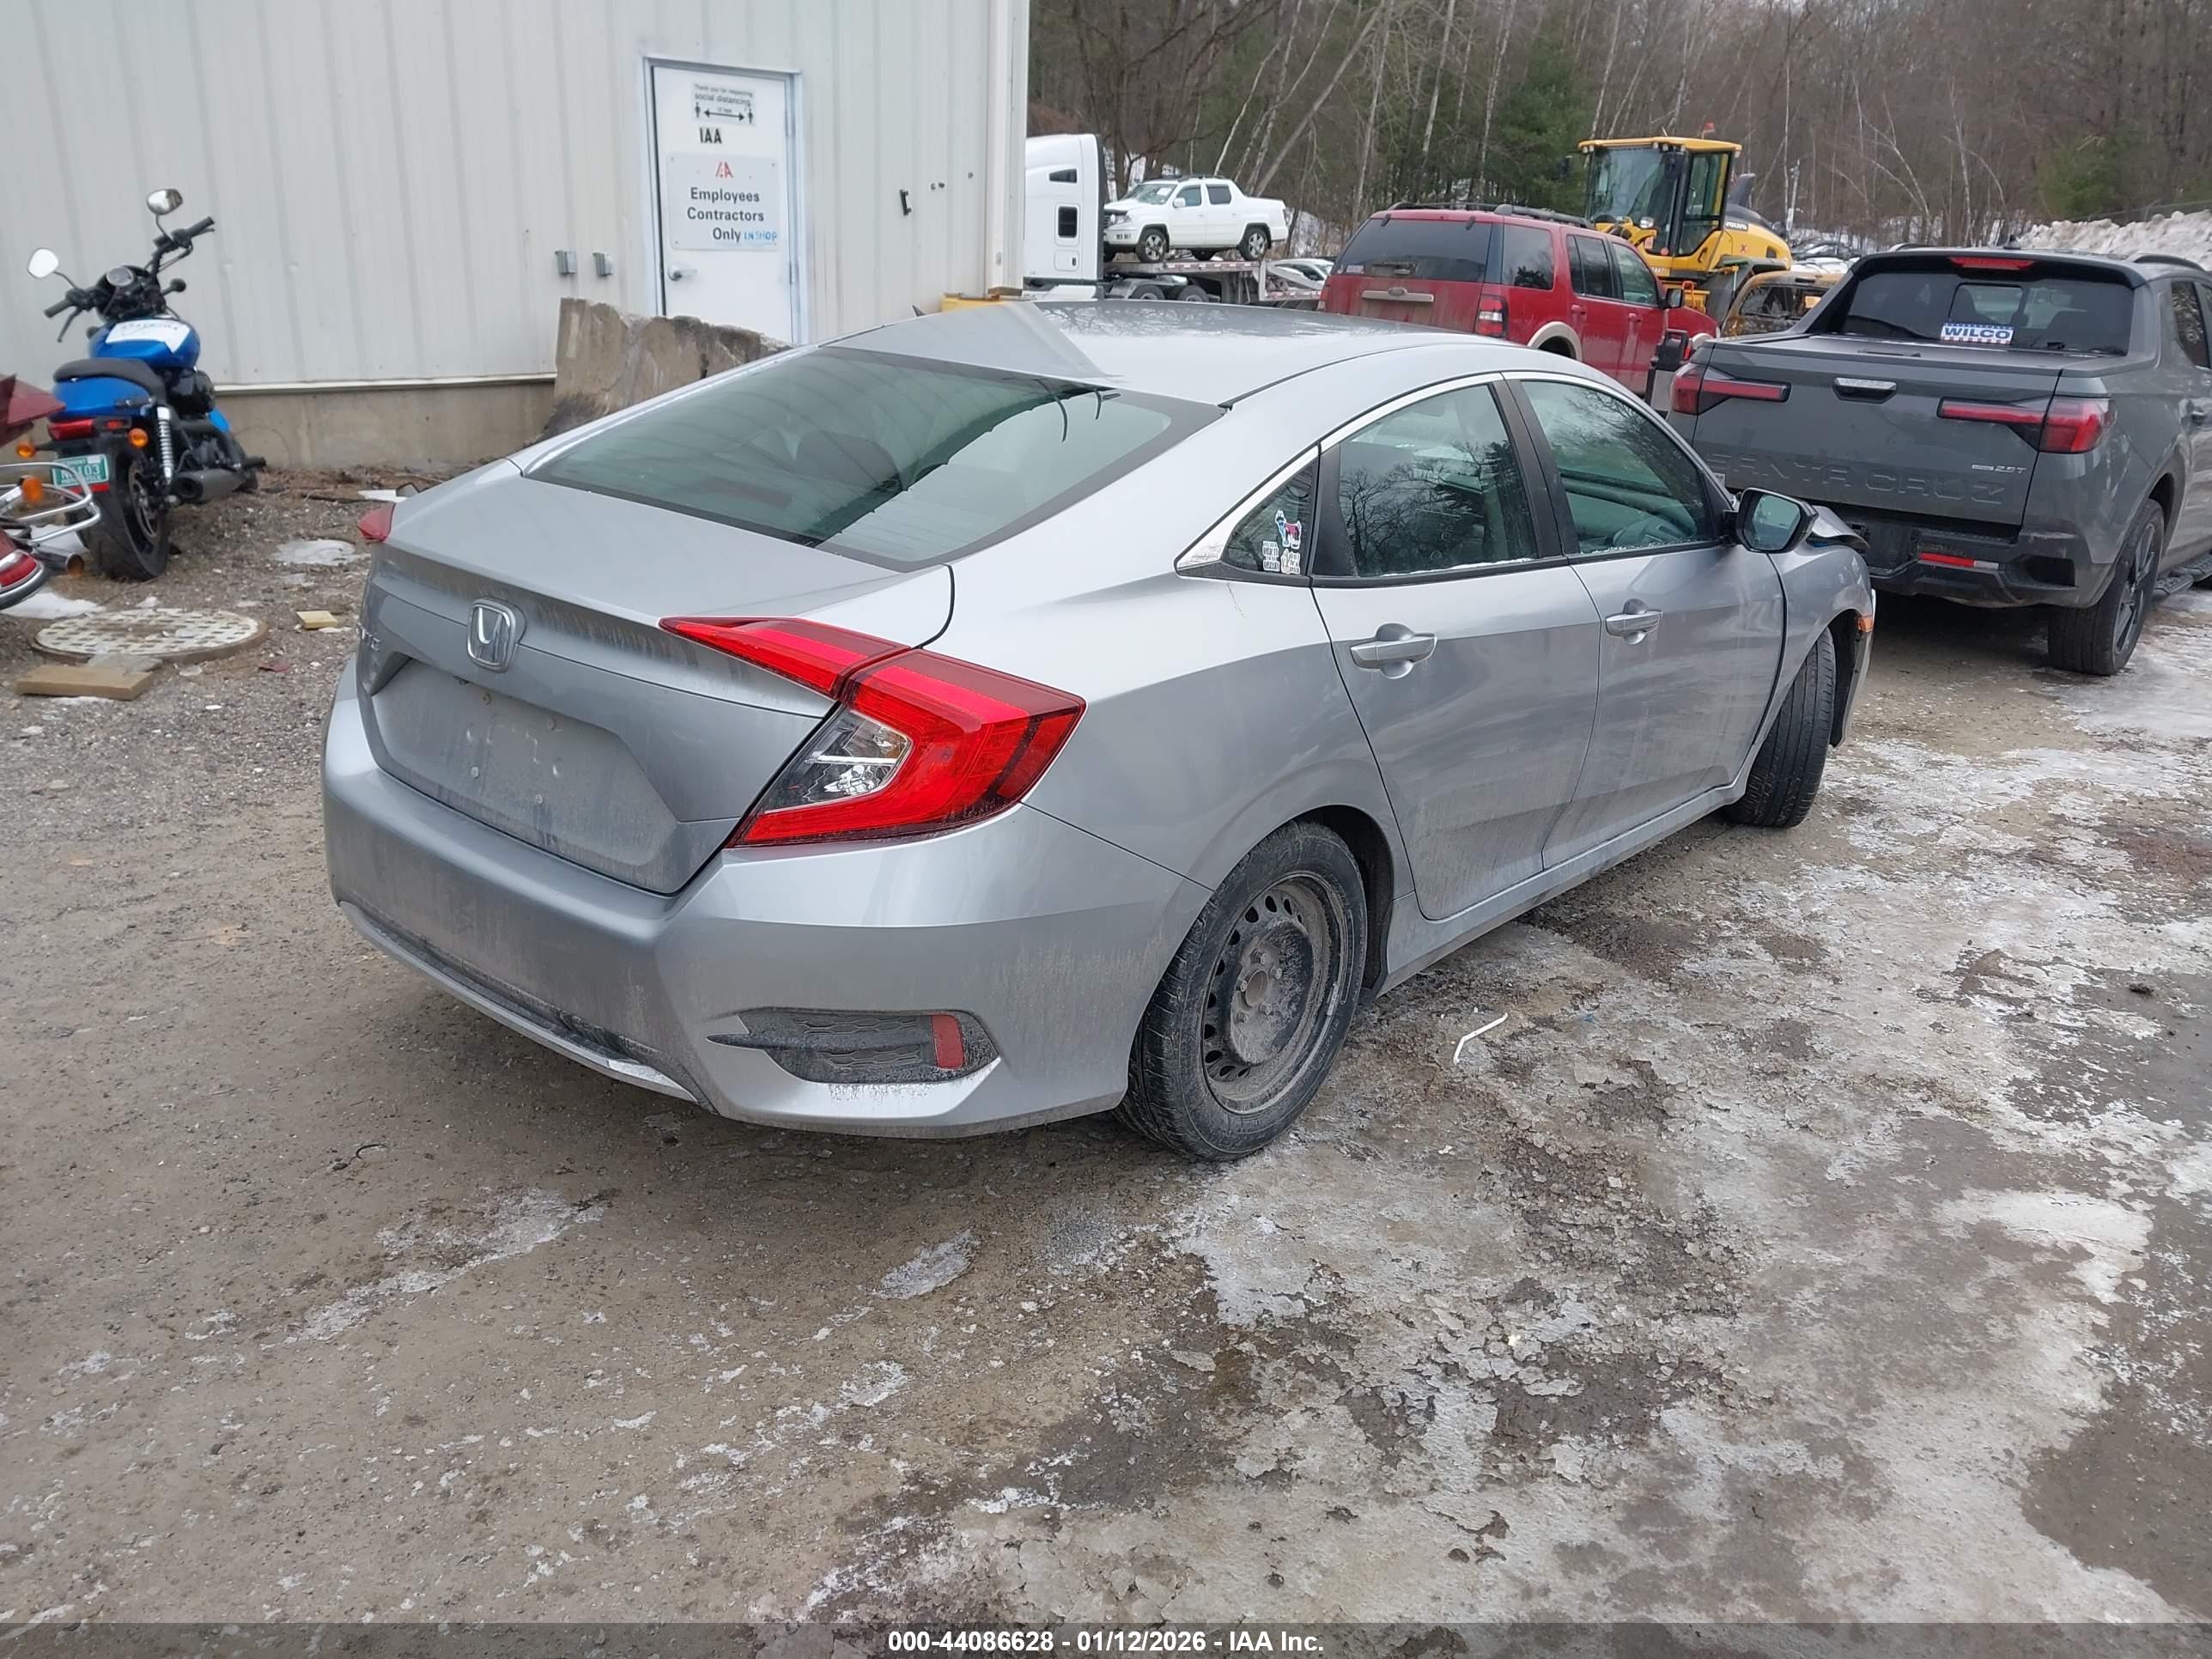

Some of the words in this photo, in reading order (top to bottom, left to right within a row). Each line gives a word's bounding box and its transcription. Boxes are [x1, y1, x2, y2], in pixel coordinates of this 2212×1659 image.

[699, 127, 722, 144] IAA
[690, 186, 760, 205] Employees
[687, 206, 764, 222] Contractors
[712, 227, 741, 243] Only
[1944, 327, 2011, 339] WILCO
[1705, 453, 1851, 488] SANTA
[1865, 472, 2006, 505] CRUZ
